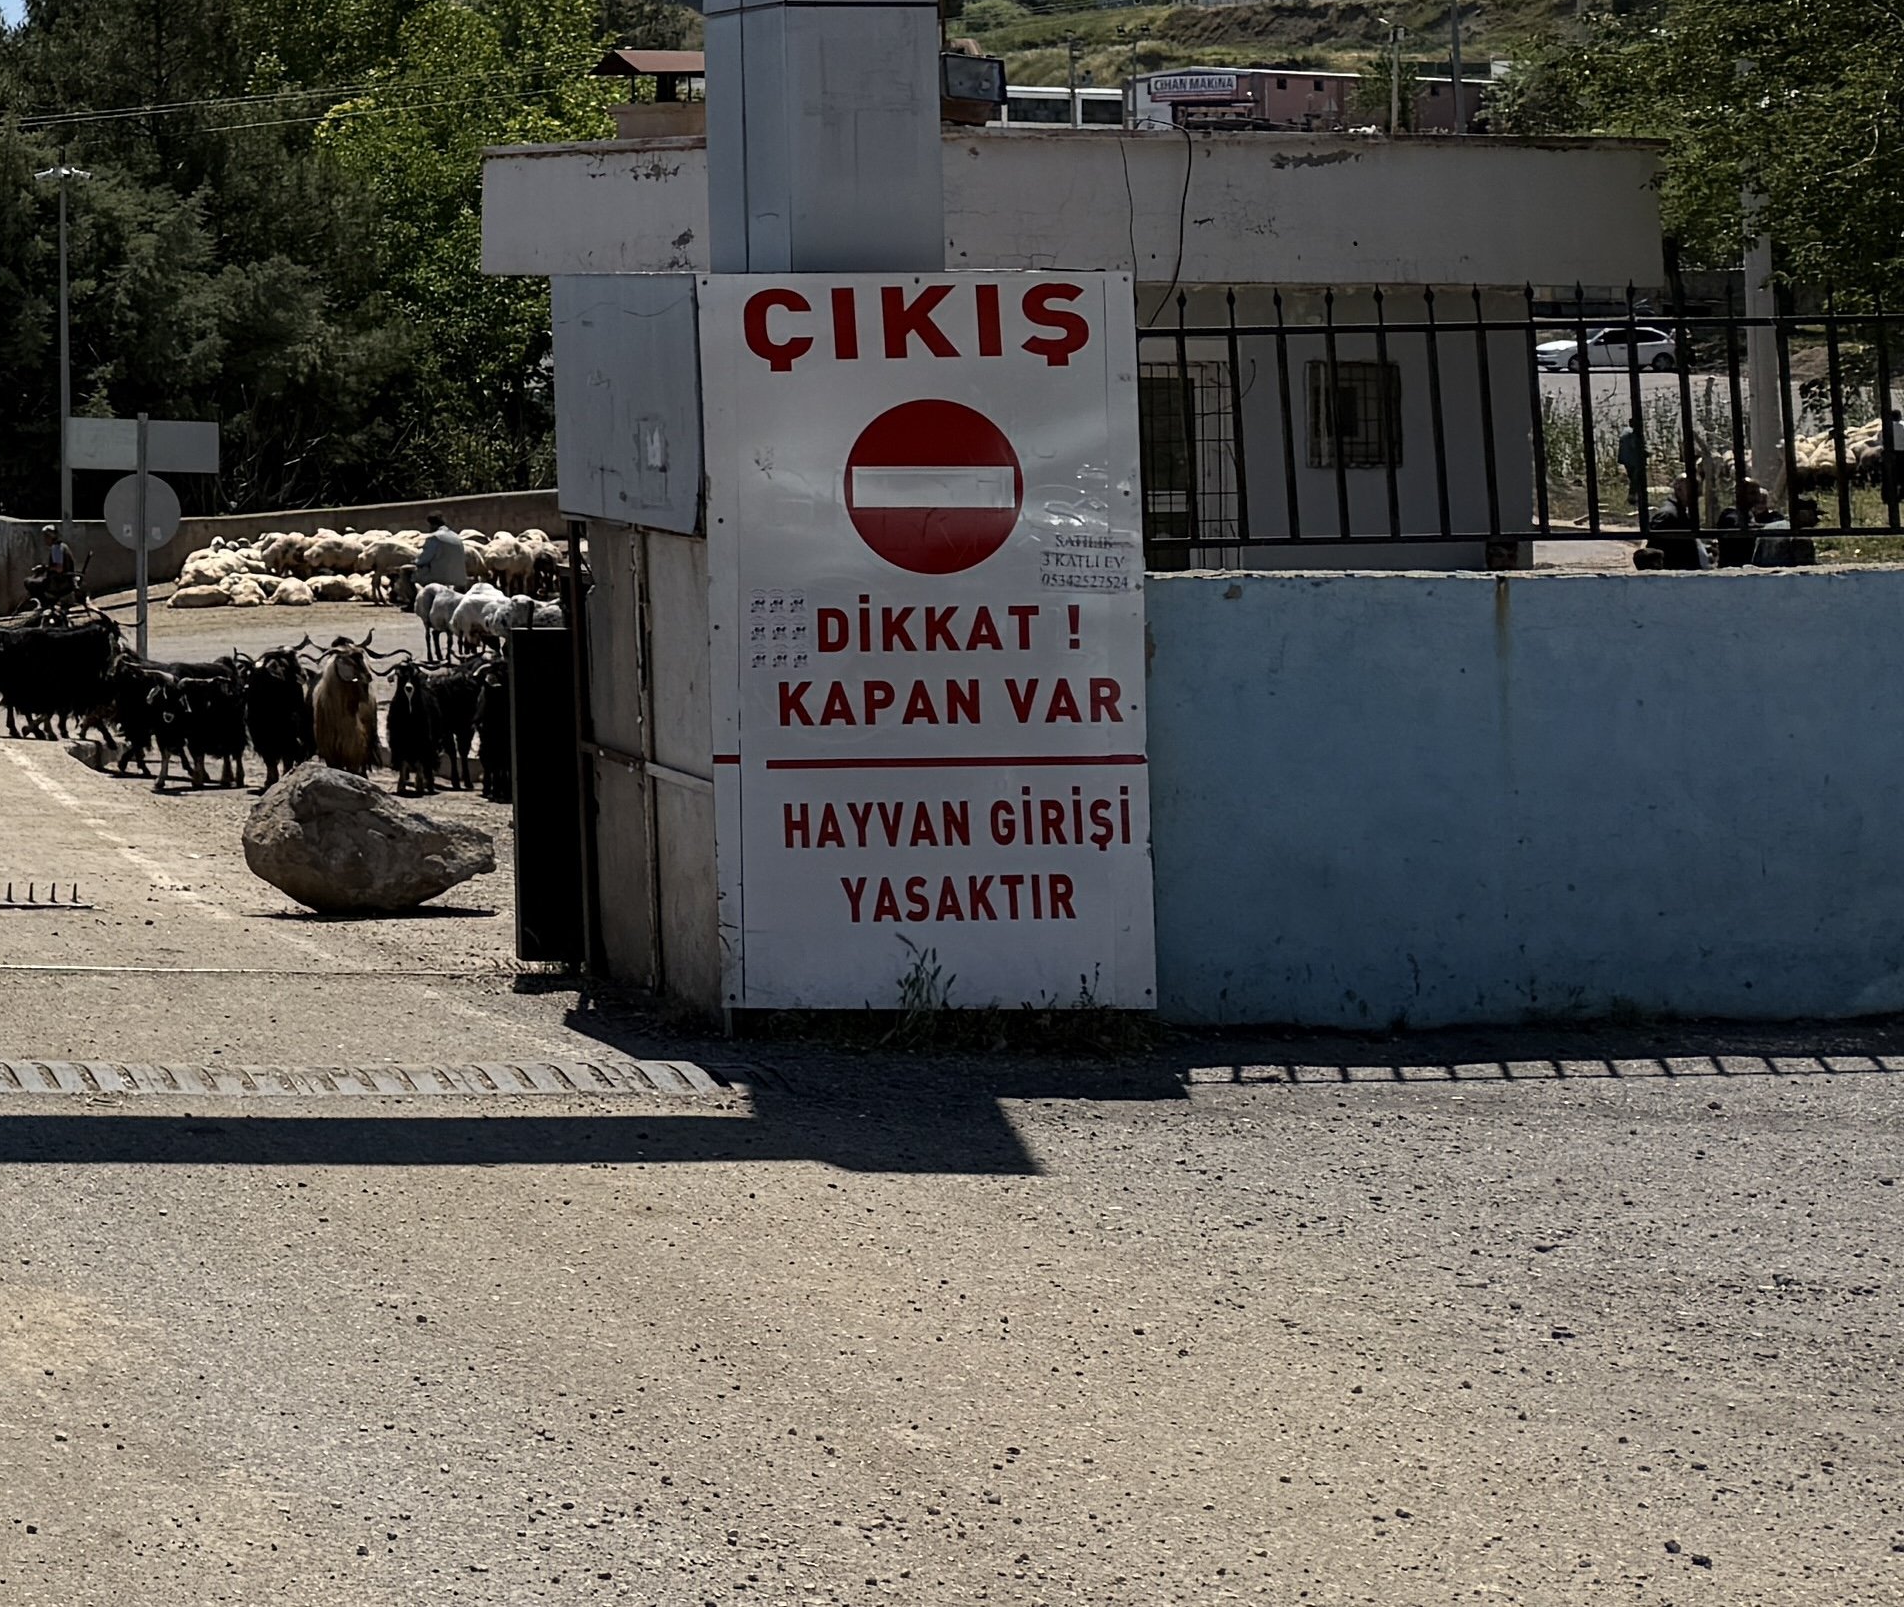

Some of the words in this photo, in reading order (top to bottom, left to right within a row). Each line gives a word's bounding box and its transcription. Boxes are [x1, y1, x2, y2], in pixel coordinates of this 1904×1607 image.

[743, 283, 1090, 372] ÇIKIŞ
[817, 594, 1040, 653] DİKKAT
[777, 678, 981, 727] KAPAN
[1005, 676, 1124, 725] VAR
[784, 799, 972, 850] HAYVAN
[990, 785, 1132, 852] GİRİŞİ
[840, 872, 1077, 924] YASAKTIR
